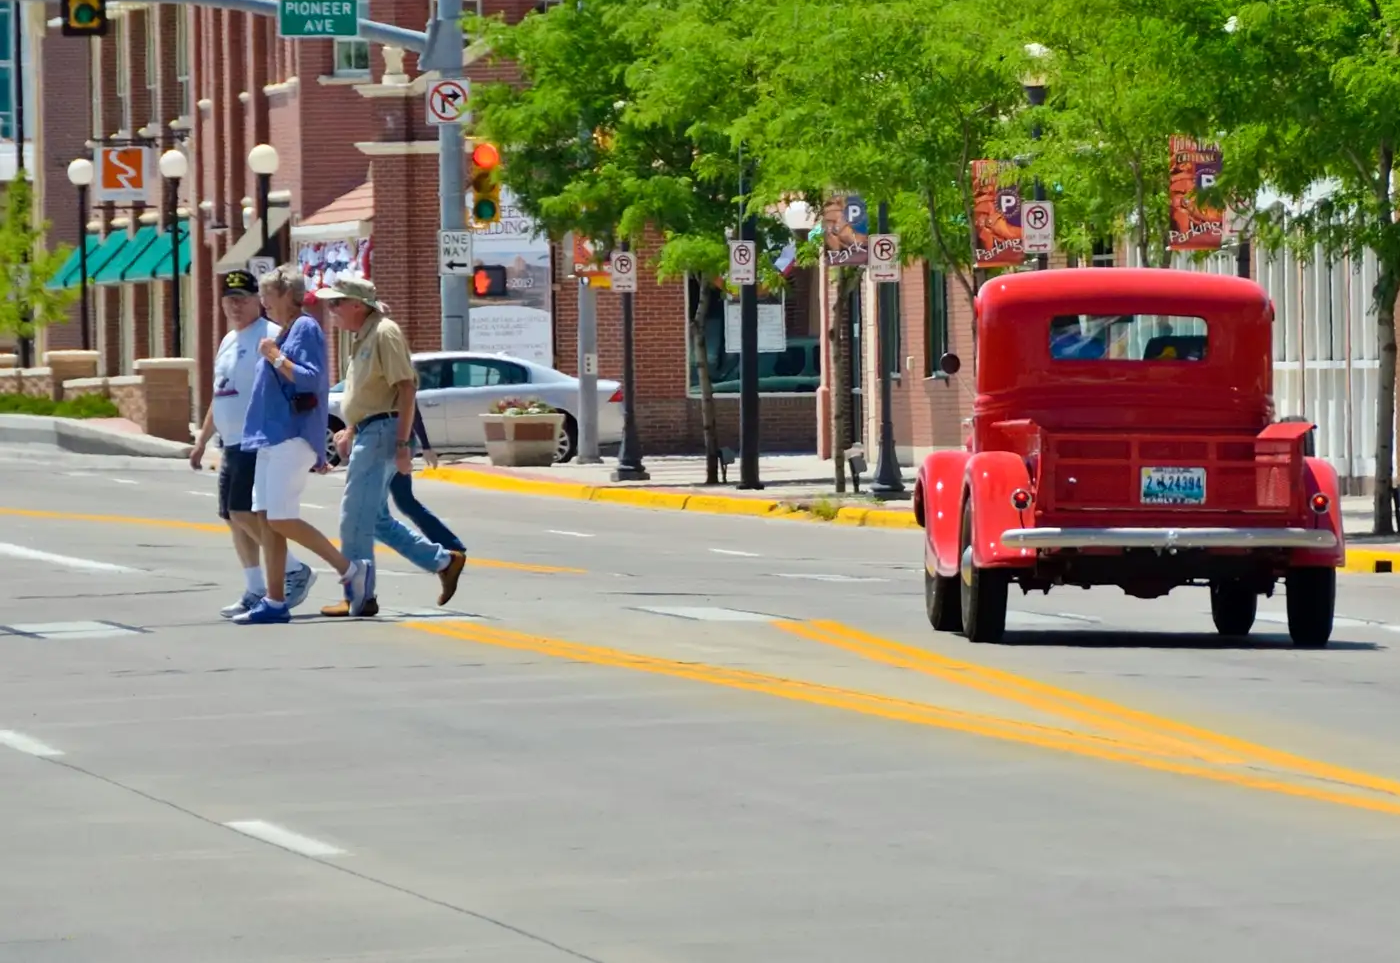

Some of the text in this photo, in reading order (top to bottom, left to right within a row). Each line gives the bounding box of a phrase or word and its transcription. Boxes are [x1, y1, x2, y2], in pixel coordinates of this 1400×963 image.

[285, 1, 352, 15] PIONEER
[303, 19, 335, 32] AVE
[1001, 196, 1016, 213] P
[848, 206, 861, 222] P
[443, 233, 467, 244] ONE
[1169, 221, 1222, 243] Parking
[443, 246, 468, 257] WAY
[827, 233, 867, 263] Park
[975, 238, 1023, 261] Parking
